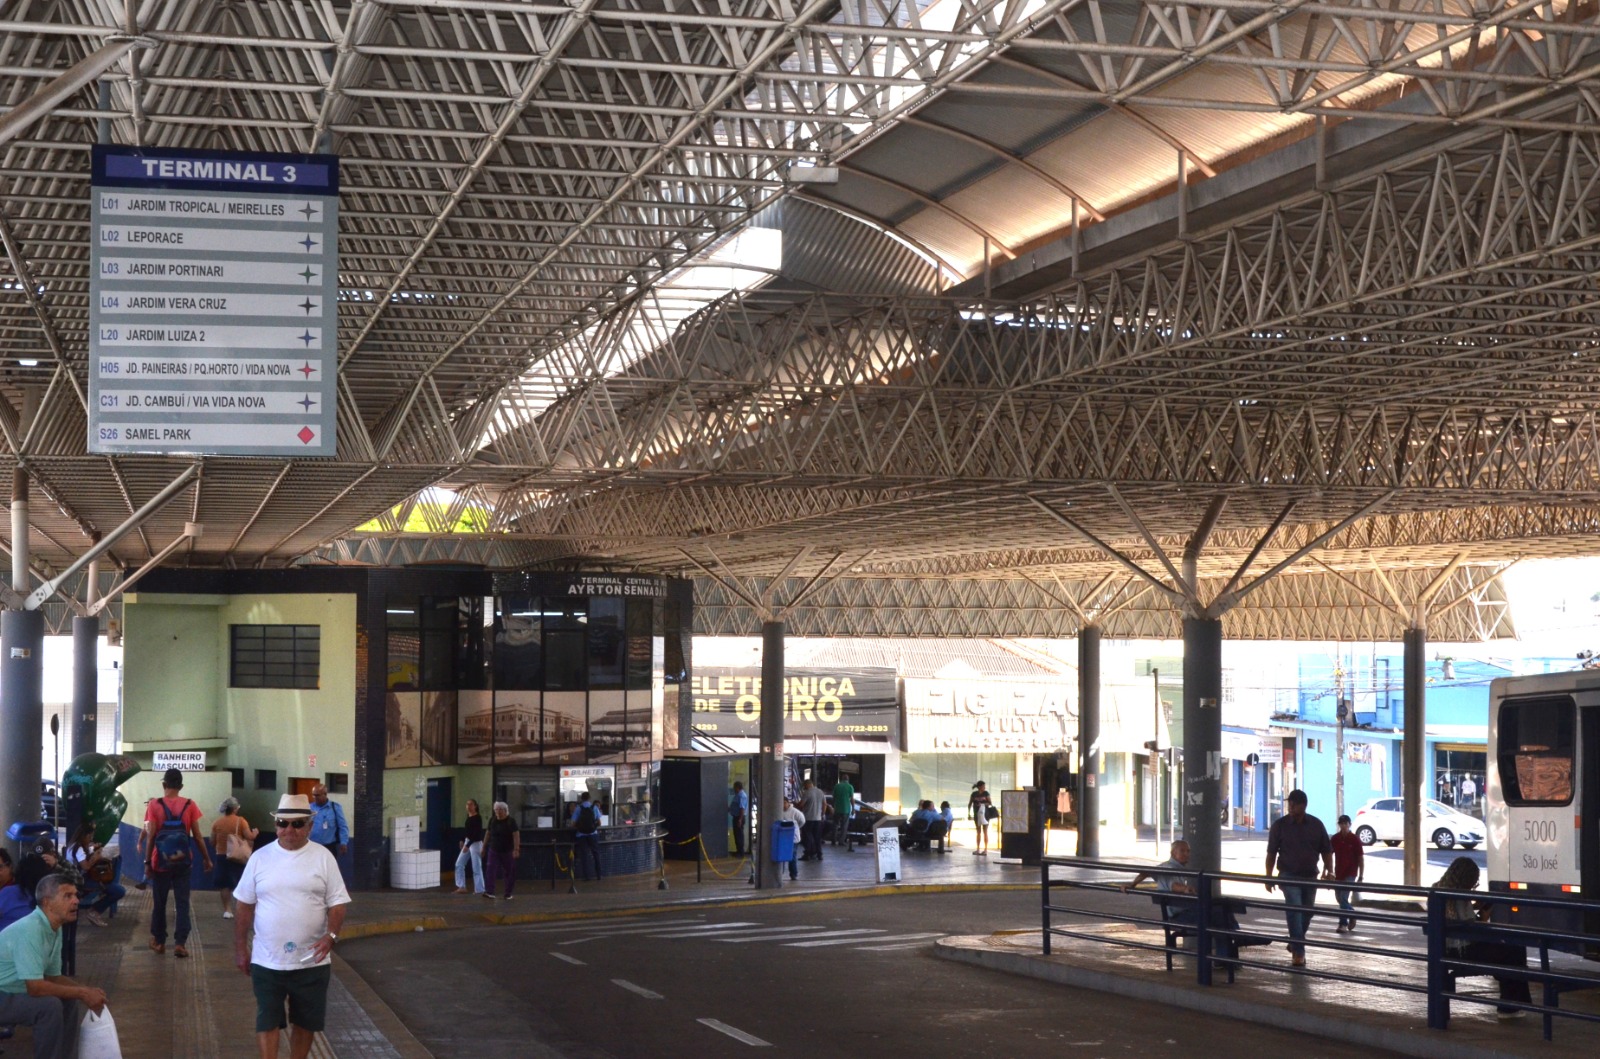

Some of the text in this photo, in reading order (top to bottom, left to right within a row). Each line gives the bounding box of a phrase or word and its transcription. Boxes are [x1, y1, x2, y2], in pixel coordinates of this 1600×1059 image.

[141, 159, 297, 183] TERMINAL 3
[102, 198, 285, 216] L01 JARDIM TROPICAL / MEIRELLES
[102, 230, 184, 244] L02 LEPORACE
[101, 262, 224, 277] L03 JARDIM PORTINARI
[101, 297, 227, 310] L04 JARDIM VERA CRUZ
[101, 329, 206, 342] L20 JARDIM LUIZA 2
[100, 362, 119, 373] H05
[126, 362, 140, 374] JD.
[142, 362, 187, 375] PAINEIRAS
[194, 363, 239, 376] PQ.HORTO
[245, 364, 266, 375] VIDA
[267, 364, 291, 376] NOVA
[100, 393, 266, 408] C31 JD. CAMBUÍ / VIA VIDA NOVA
[100, 428, 191, 440] S26 SAMEL PARK
[581, 577, 621, 585] TERMINAL
[626, 577, 652, 586] CENTRAL
[567, 584, 622, 595] AYRTON
[624, 585, 654, 597] SENNA
[692, 676, 856, 697] ELETNICA
[694, 694, 843, 722] DE ORO
[157, 753, 202, 761] BANHEIRO
[153, 762, 205, 770] MASCULINO
[570, 768, 605, 776] BILHETES
[1524, 820, 1557, 842] 5000
[1522, 854, 1558, 871] São José
